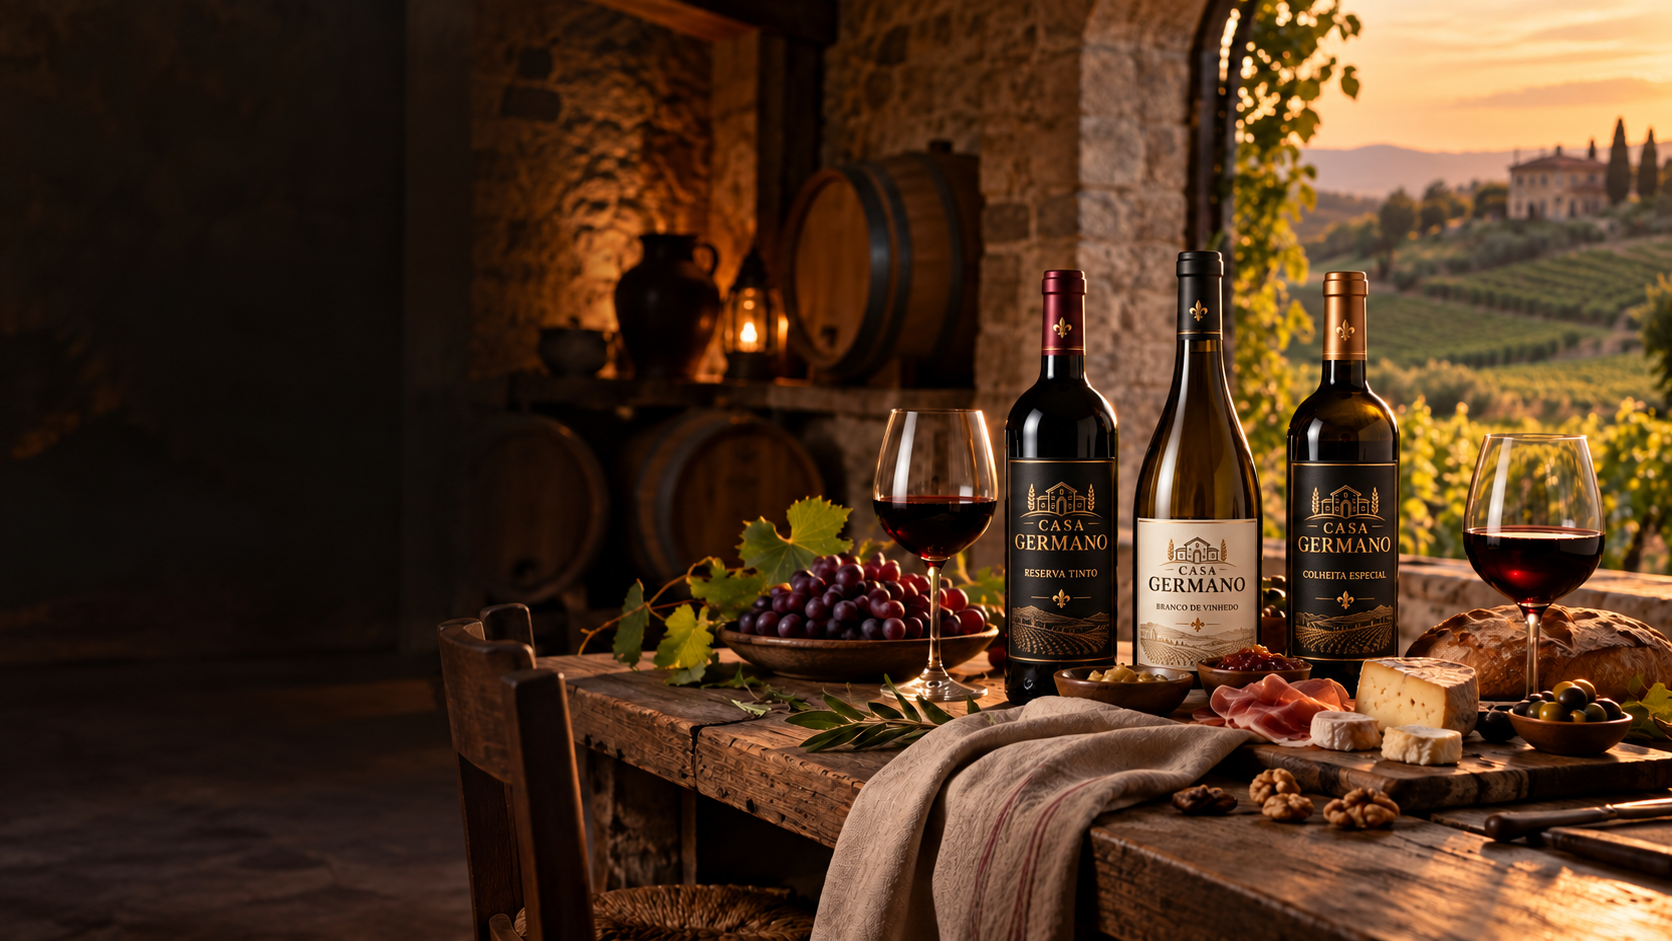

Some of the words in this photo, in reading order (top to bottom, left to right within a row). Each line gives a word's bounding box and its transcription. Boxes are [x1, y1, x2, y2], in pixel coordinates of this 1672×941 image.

[1038, 519, 1084, 532] CASA
[1323, 522, 1368, 534] CASA
[1014, 533, 1108, 551] GERMANO
[1298, 535, 1391, 554] GERMANO
[1024, 568, 1066, 578] RESERVA
[1068, 568, 1098, 578] TINTO
[1178, 565, 1217, 576] CASA
[1302, 570, 1347, 580] COLHEITA
[1349, 570, 1387, 580] ESPECIAL
[1148, 576, 1246, 593] GERMANO
[1156, 603, 1188, 612] BRANCO
[1190, 603, 1201, 612] DE
[1203, 603, 1239, 612] VINHEDO
